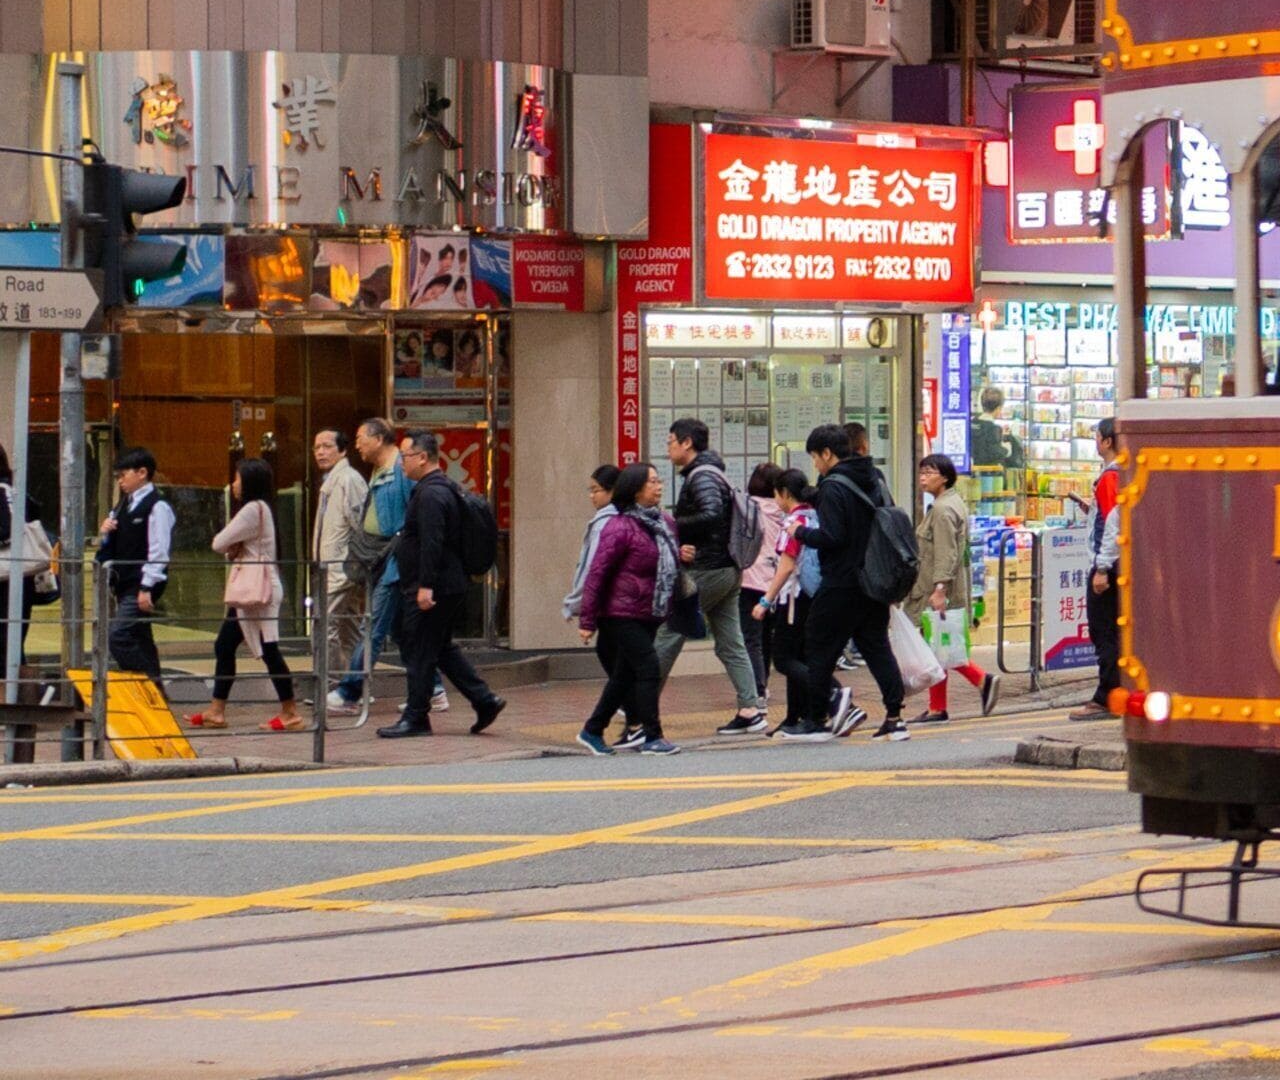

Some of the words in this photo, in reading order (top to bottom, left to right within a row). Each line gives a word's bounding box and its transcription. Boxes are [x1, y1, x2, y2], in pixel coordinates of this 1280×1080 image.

[150, 164, 302, 200] IME
[339, 166, 562, 209] MANSION
[718, 158, 958, 212] 金龍地產公司
[717, 213, 758, 240] GOLD
[761, 214, 823, 242] DRAGON
[825, 216, 899, 244] PROPERTY
[901, 221, 957, 246] AGENCY
[618, 247, 646, 260] GOLD
[648, 246, 691, 260] DRAGON
[629, 263, 678, 276] PROPERTY
[794, 254, 835, 280] 9123
[914, 257, 952, 281] 9070
[5, 275, 45, 292] Road
[635, 279, 675, 293] AGENCY
[1006, 301, 1070, 330] BEST
[1078, 302, 1178, 333] PHAMA
[1189, 304, 1275, 337] LIMID
[622, 310, 638, 440] 金龍地產公司
[1059, 569, 1089, 589] 舊樓
